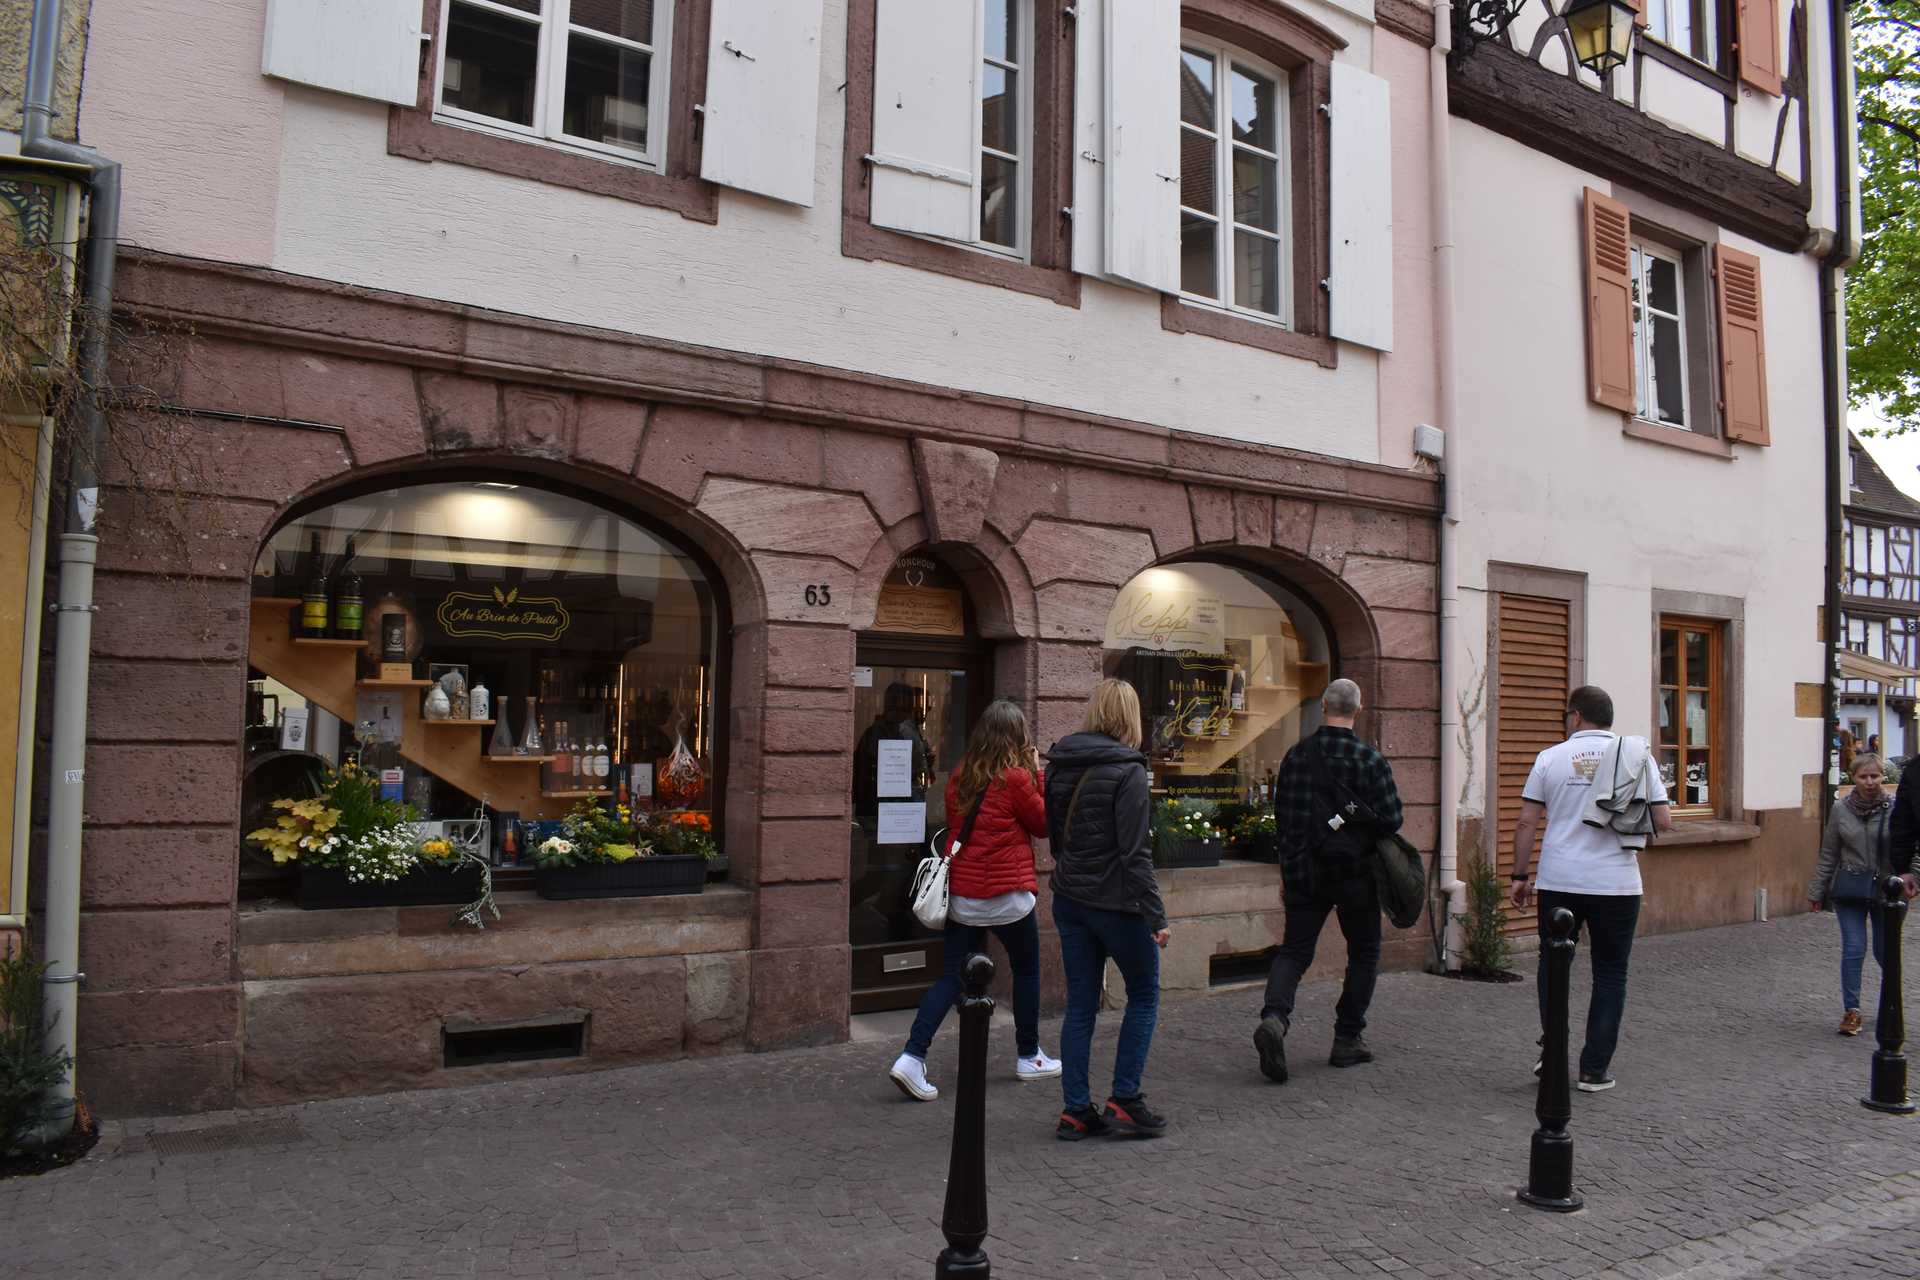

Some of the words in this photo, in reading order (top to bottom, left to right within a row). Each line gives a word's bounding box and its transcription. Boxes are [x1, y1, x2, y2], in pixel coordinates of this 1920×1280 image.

[805, 584, 831, 607] 63
[450, 608, 474, 621] Au
[476, 608, 505, 622] Brin
[506, 613, 519, 623] de
[521, 611, 559, 625] Paille
